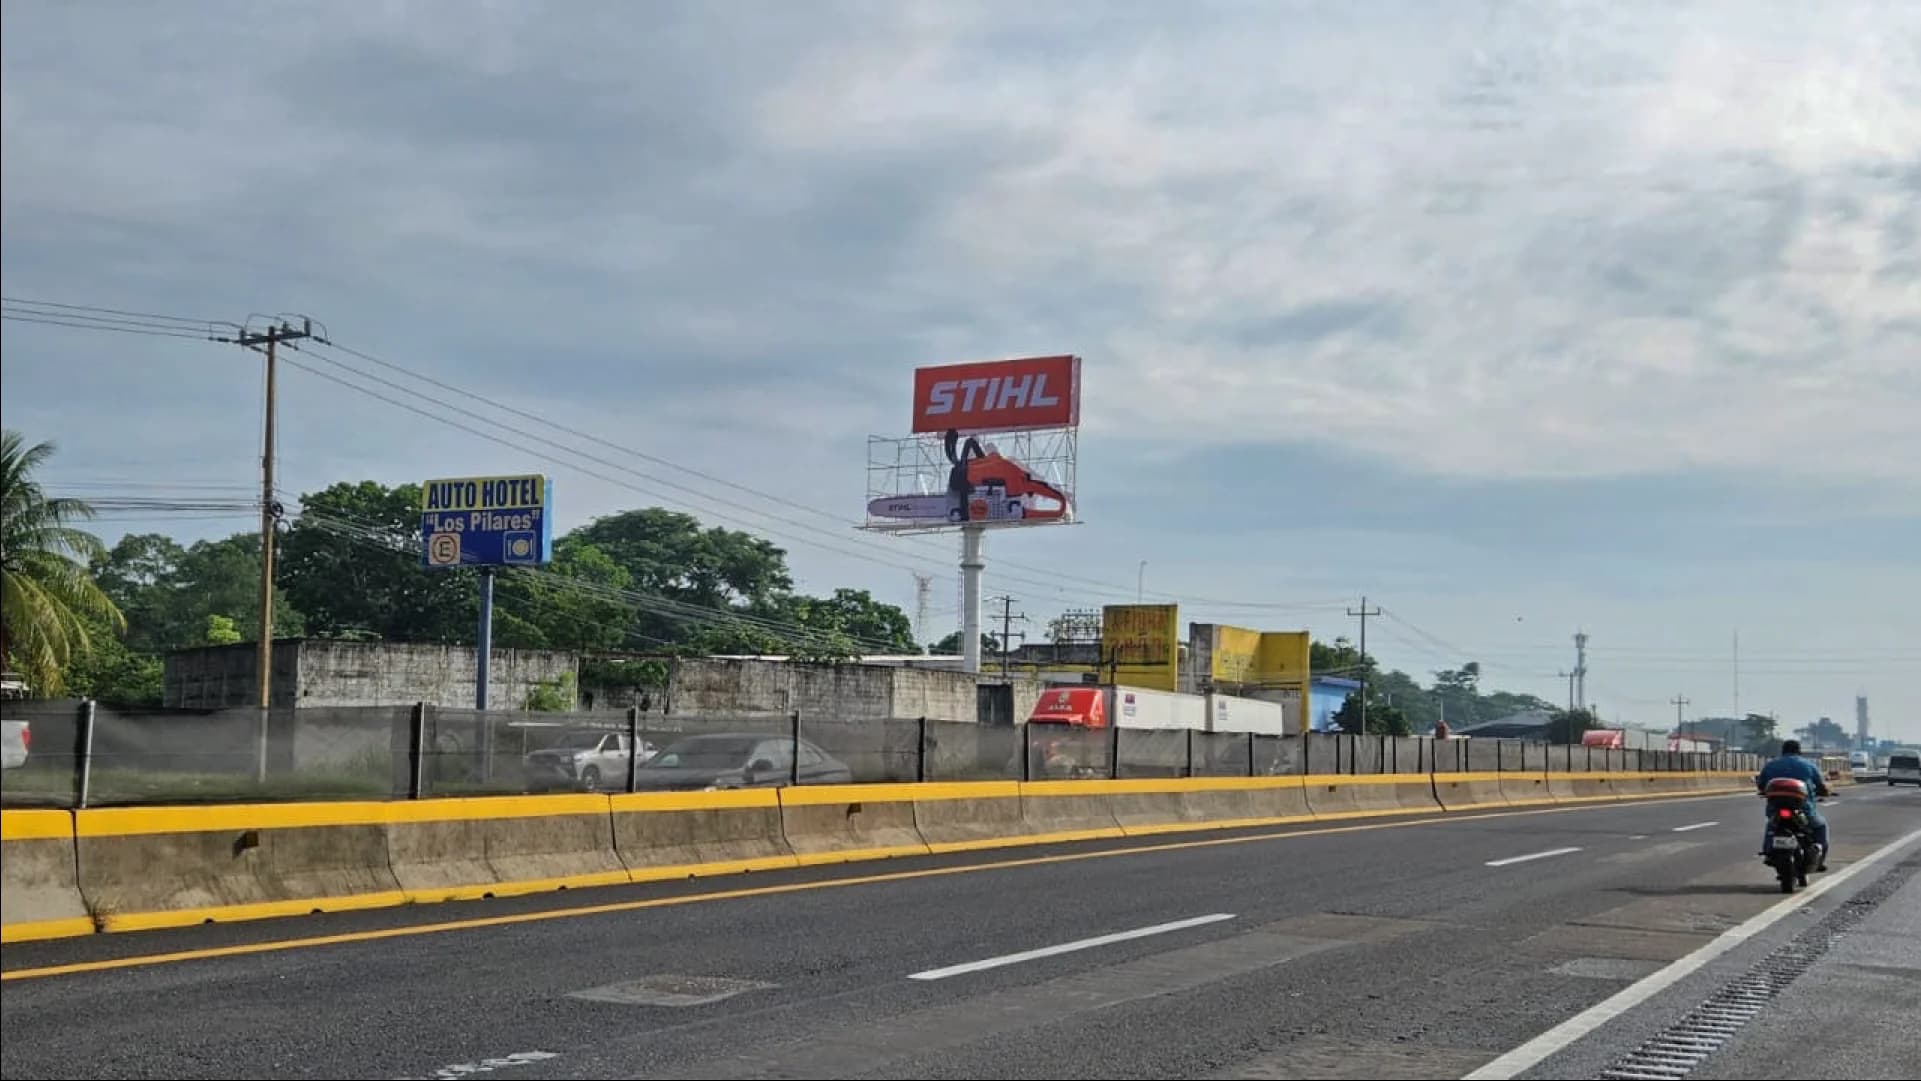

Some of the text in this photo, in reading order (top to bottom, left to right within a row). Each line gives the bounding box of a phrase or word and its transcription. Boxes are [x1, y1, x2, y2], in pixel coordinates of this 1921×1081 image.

[925, 373, 1059, 415] STIHL
[428, 478, 540, 510] AUTO HOTEL
[426, 509, 541, 533] "Los Pilares"
[440, 541, 451, 557] E
